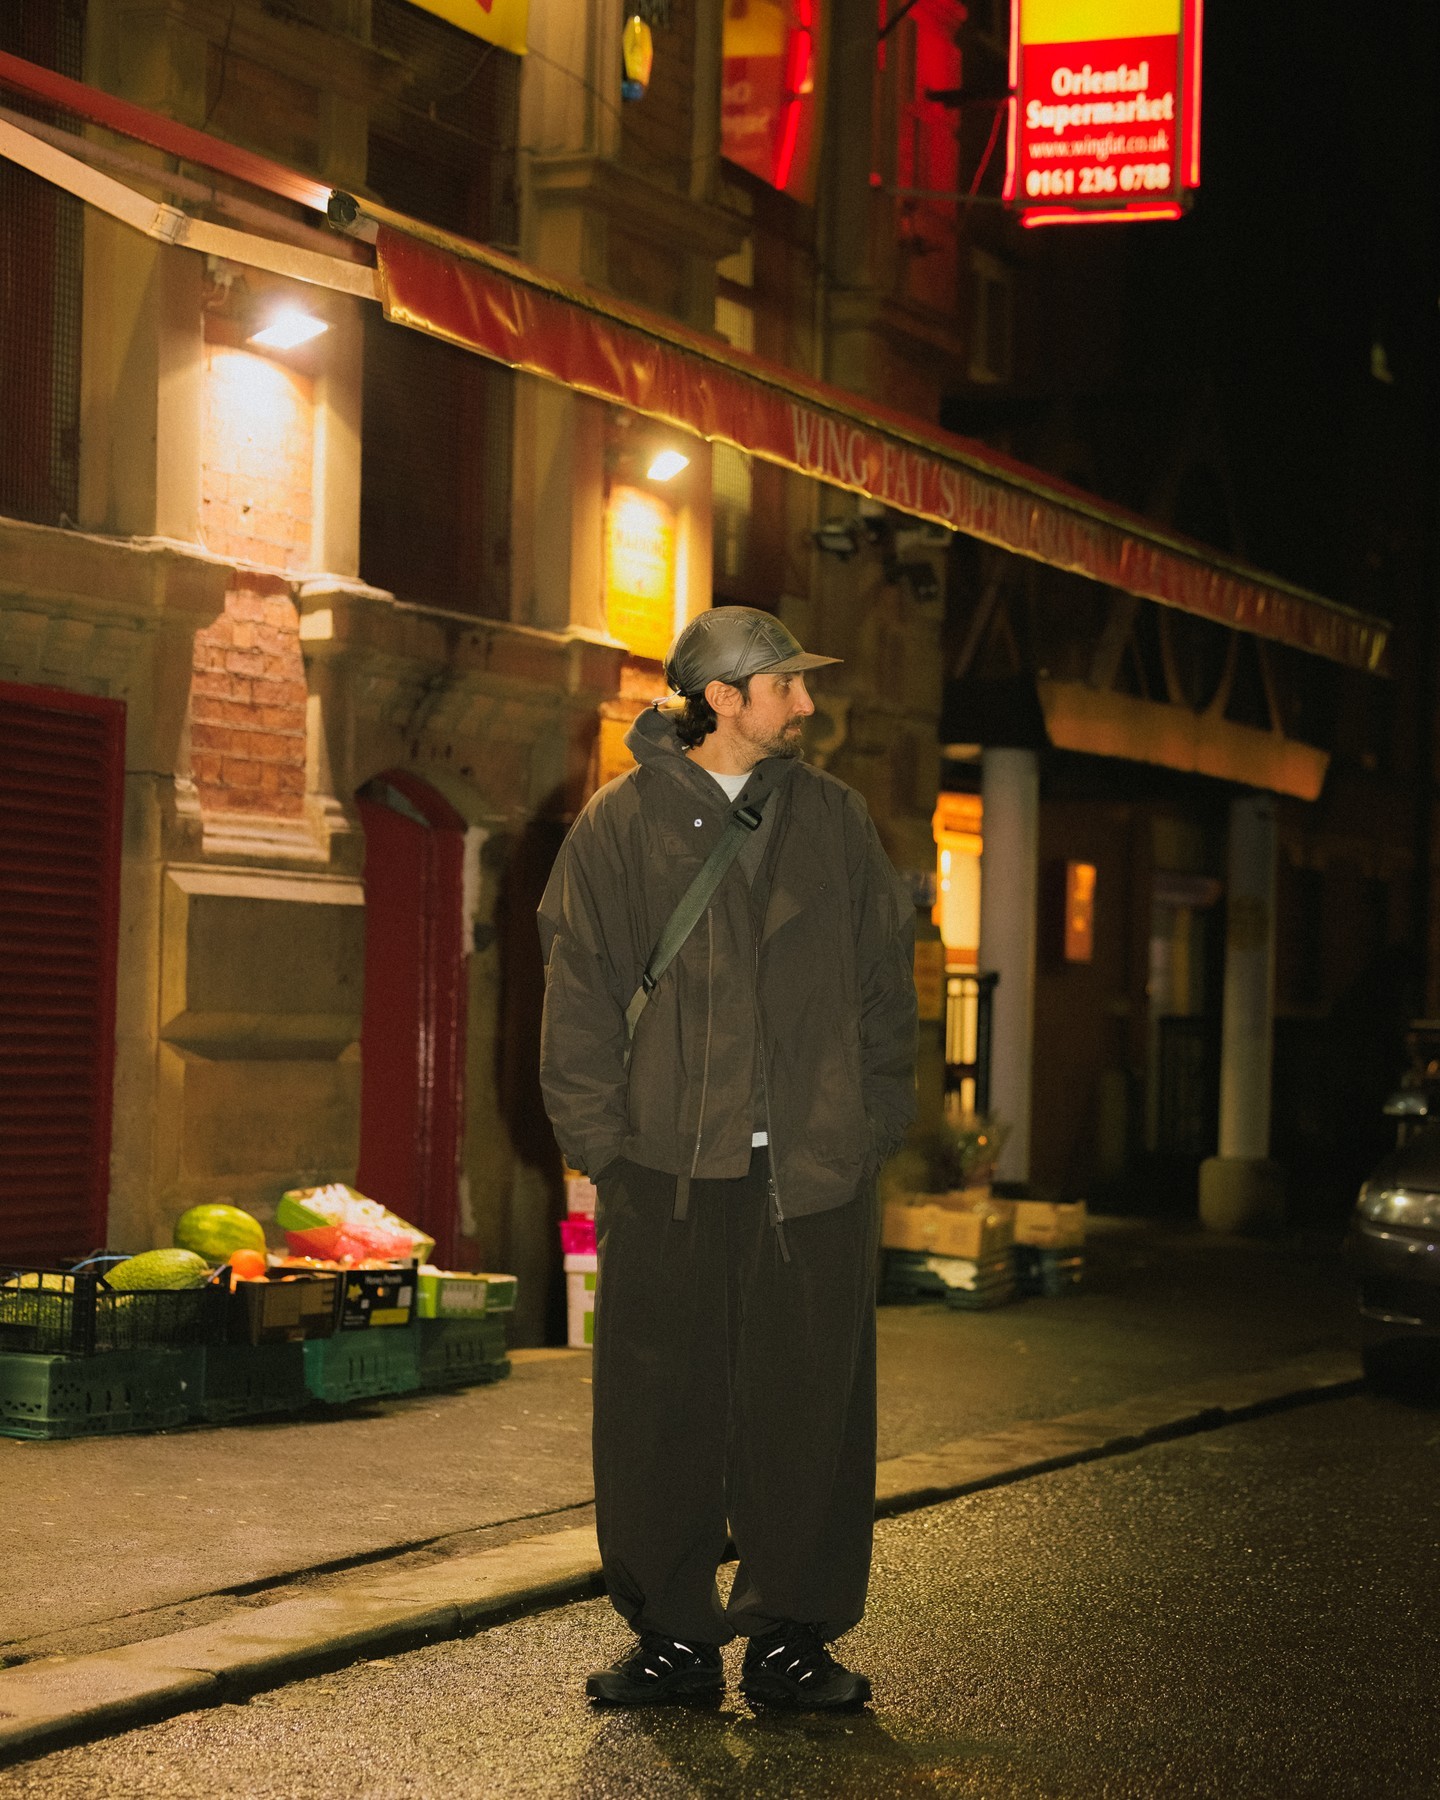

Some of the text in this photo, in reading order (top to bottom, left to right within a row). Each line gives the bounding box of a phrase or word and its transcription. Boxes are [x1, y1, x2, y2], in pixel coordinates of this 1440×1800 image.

[1051, 61, 1149, 96] Oriental
[1026, 92, 1174, 135] Supermarket
[1026, 168, 1074, 196] 0161
[1078, 166, 1117, 193] 236
[791, 403, 868, 487] WING
